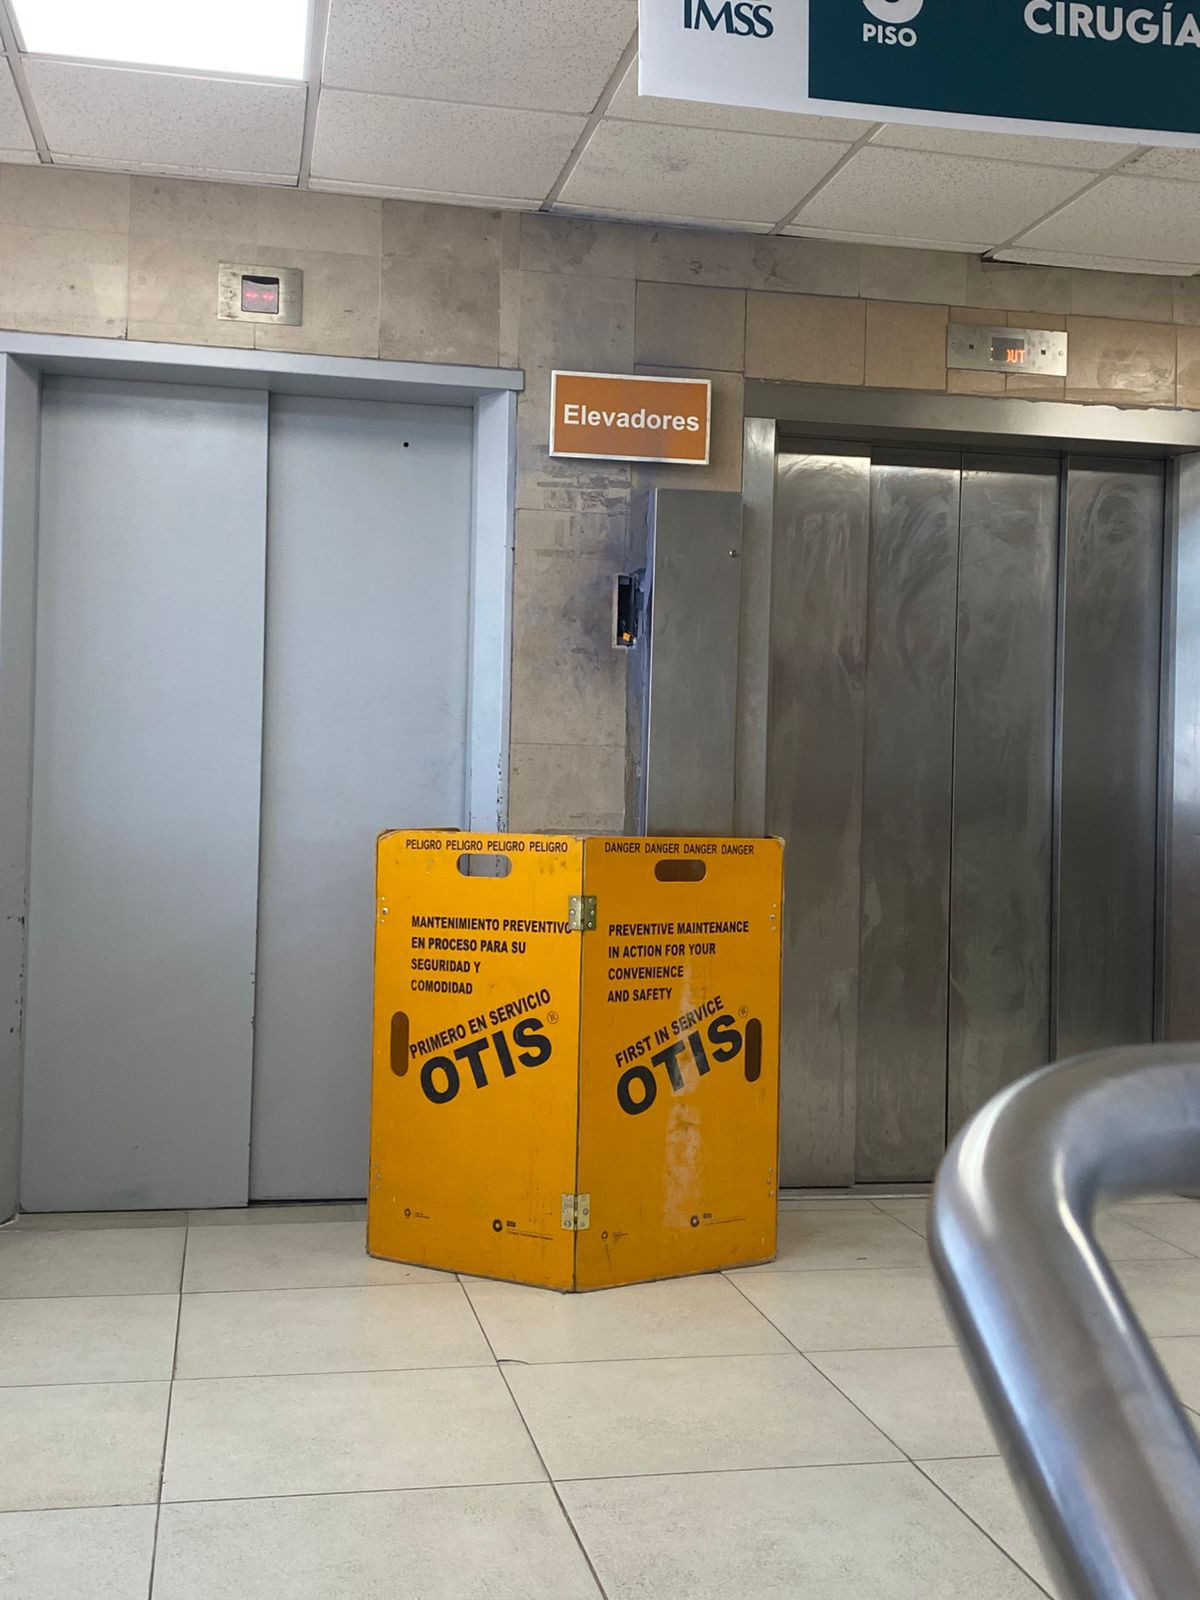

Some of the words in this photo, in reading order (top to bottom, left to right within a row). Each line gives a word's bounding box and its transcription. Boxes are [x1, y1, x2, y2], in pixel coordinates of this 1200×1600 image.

[683, 0, 774, 38] IMSS
[1023, 0, 1200, 48] CIRUGÍA
[862, 23, 918, 47] PISO
[563, 403, 700, 432] Elevadores
[405, 839, 442, 850] PELIGRO
[446, 839, 483, 851] PELIGRO
[487, 840, 525, 852] PELIGRO
[529, 841, 568, 853] PELIGRO
[604, 842, 640, 853] DANGER
[644, 842, 680, 854] DANGER
[683, 843, 717, 855] DANGER
[721, 844, 754, 855] DANGER
[411, 915, 500, 931] MANTENIMIENTO
[608, 922, 674, 936] PREVENTIVE
[676, 921, 749, 934] MAINTENANCE
[411, 936, 425, 949] EN
[428, 937, 477, 951] PROCESO
[480, 939, 508, 953] PARA
[512, 941, 526, 954] SU
[608, 946, 619, 958] IN
[622, 944, 662, 958] ACTION
[665, 943, 685, 956] FOR
[688, 942, 716, 955] YOUR
[411, 958, 470, 973] SEGURIDAD
[473, 961, 481, 973] Y
[608, 965, 684, 980] CONVENIENCE
[411, 979, 473, 994] COMODIDAD
[607, 989, 629, 1003] AND
[632, 987, 672, 1001] SAFETY
[409, 1024, 466, 1059] PRIMERO
[468, 1014, 488, 1035] EN
[489, 988, 551, 1026] SERVICIO
[615, 1036, 652, 1068] FIRST
[654, 1026, 670, 1046] IN
[671, 995, 724, 1036] SERVICE
[420, 1017, 552, 1104] OTIS
[616, 1014, 743, 1116] OTIS
